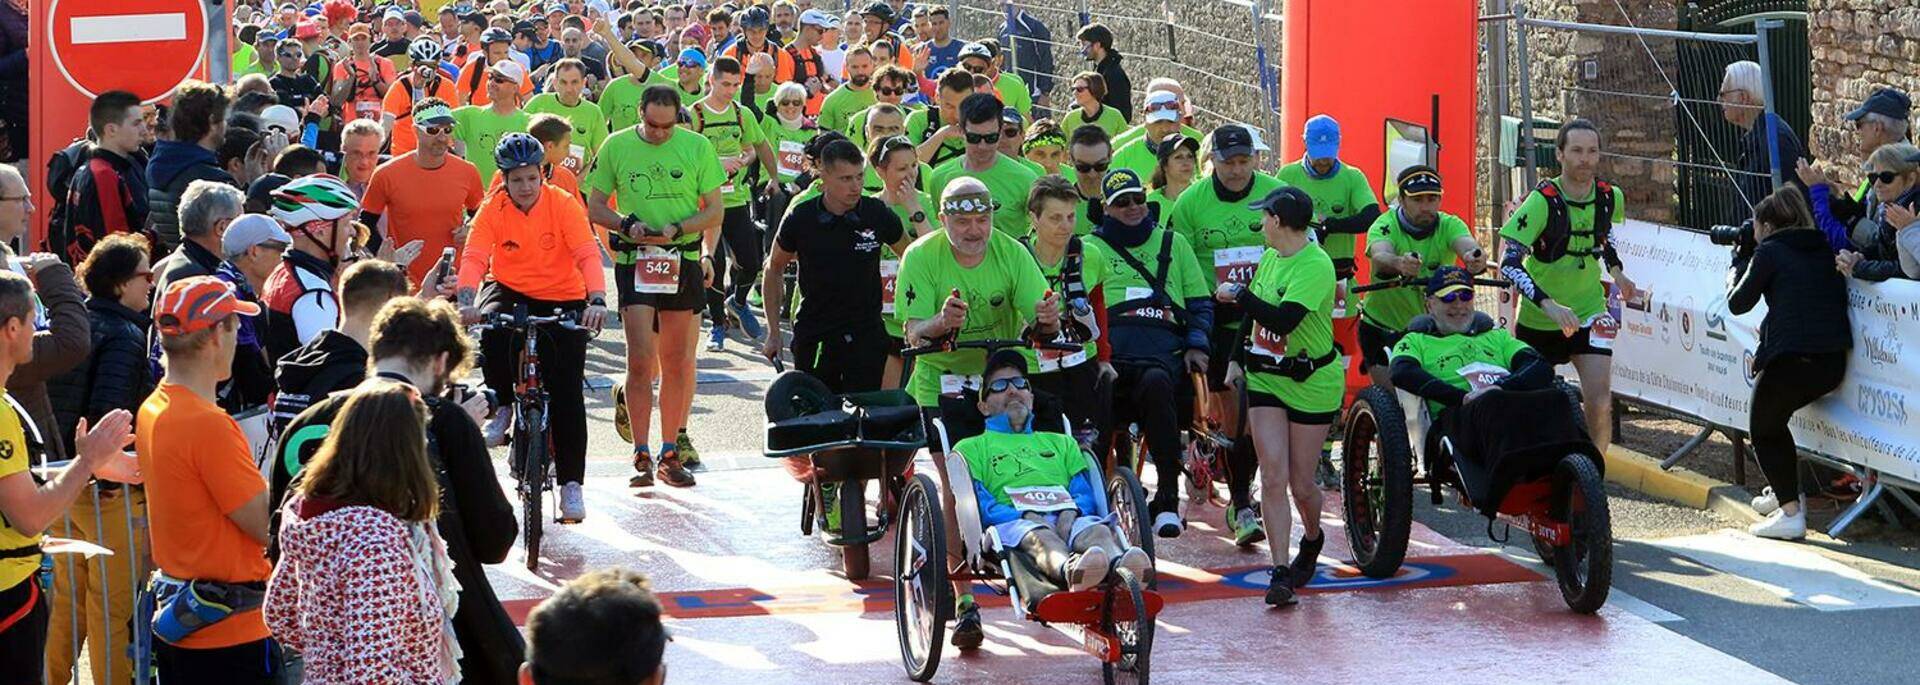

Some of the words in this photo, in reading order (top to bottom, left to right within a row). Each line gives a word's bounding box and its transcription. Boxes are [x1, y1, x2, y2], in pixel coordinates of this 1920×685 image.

[646, 261, 671, 274] 542
[1228, 266, 1254, 281] 411
[1135, 306, 1164, 320] 498
[1024, 491, 1058, 501] 404
